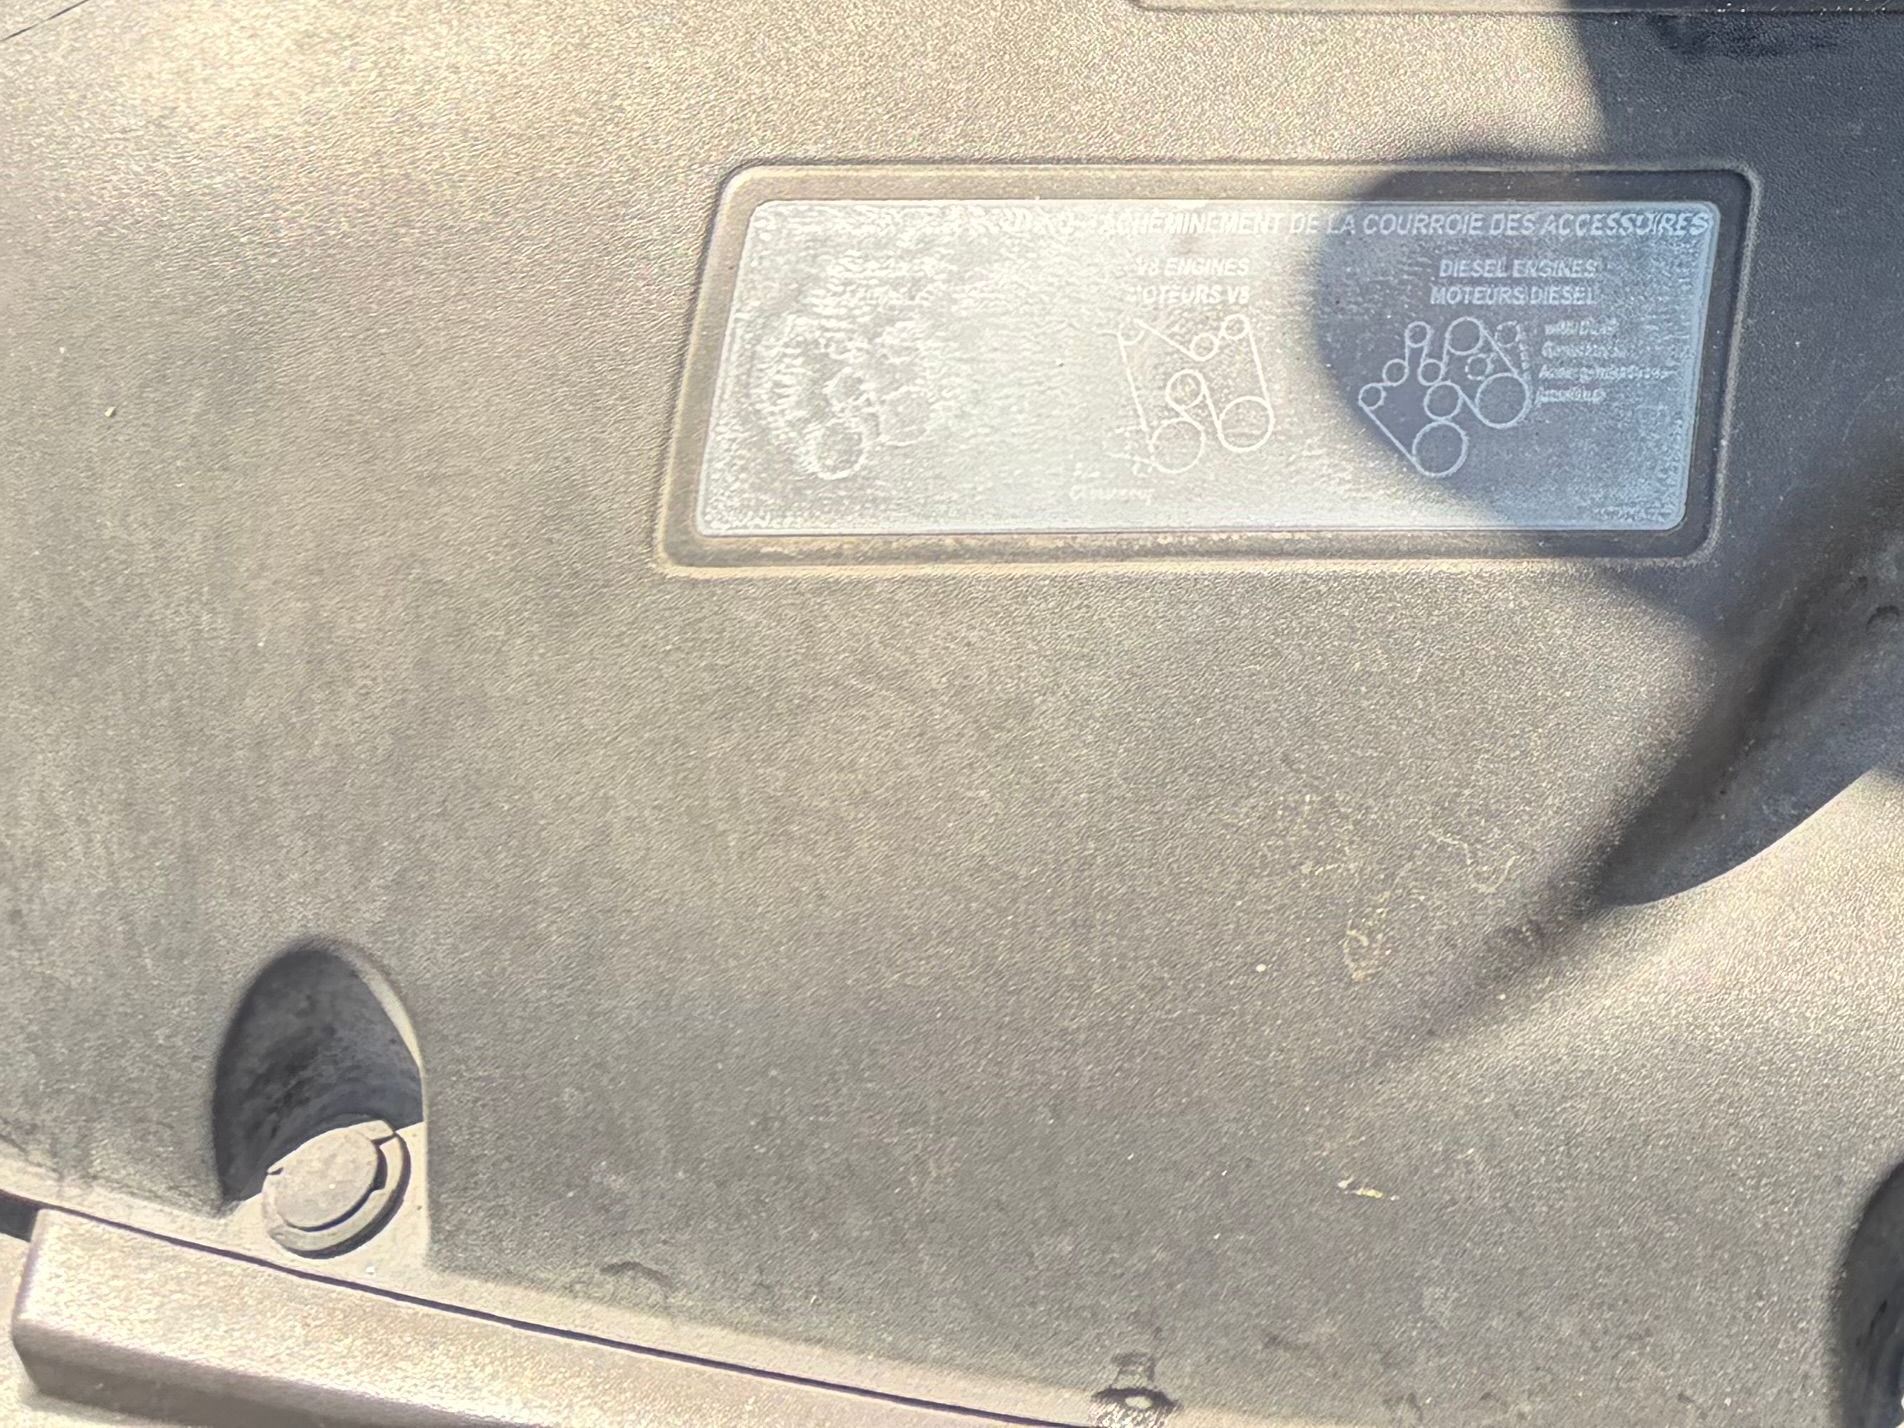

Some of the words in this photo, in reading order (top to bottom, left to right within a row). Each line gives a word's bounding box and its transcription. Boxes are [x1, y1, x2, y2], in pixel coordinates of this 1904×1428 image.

[1289, 213, 1319, 236] DE
[1326, 213, 1357, 236] LA
[1363, 213, 1485, 236] COURROIE
[1489, 213, 1537, 236] DES
[1542, 211, 1712, 236] ACCESSOIRES
[1163, 257, 1250, 277] ENGINES
[1439, 258, 1508, 278] DIESEL
[1512, 259, 1598, 278] ENGINES
[1131, 284, 1222, 305] OTEURS
[1226, 284, 1250, 305] V8
[1430, 286, 1529, 305] MOTEURS
[1530, 285, 1598, 305] DIESEL
